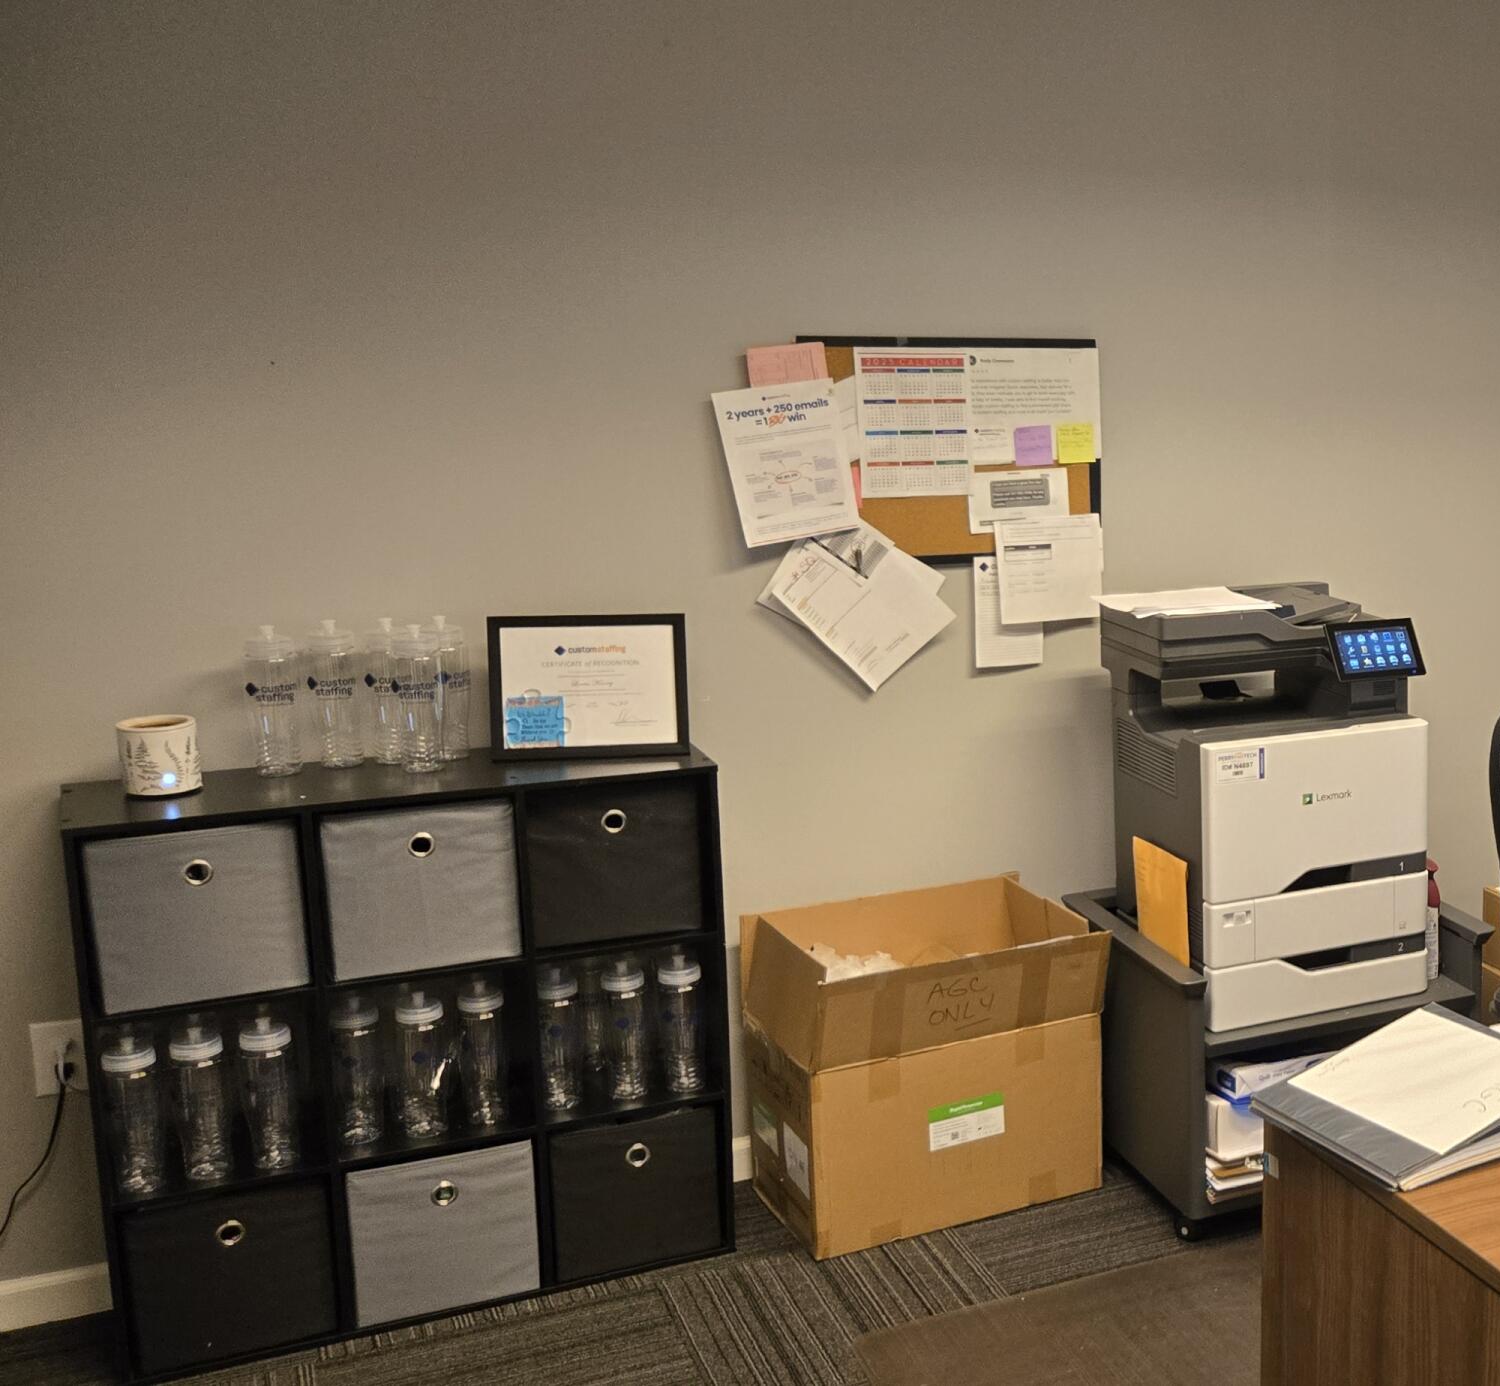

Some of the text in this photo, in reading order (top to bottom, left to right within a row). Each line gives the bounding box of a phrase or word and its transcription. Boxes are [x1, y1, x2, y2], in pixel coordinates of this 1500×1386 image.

[899, 358, 960, 366] CALENDAR
[725, 410, 734, 421] 2
[734, 407, 765, 422] years
[773, 402, 793, 414] 250
[794, 397, 829, 411] emails
[787, 411, 807, 423] win
[593, 659, 640, 667] RECOGNITION
[260, 683, 298, 694] custom
[319, 677, 356, 688] custom
[256, 691, 295, 703] staffing
[315, 686, 353, 698] staffing
[399, 690, 435, 702] staffing
[1316, 789, 1352, 802] Lexmark
[1399, 861, 1405, 872] 1
[1398, 942, 1404, 952] 2
[926, 976, 989, 1005] AGC
[928, 993, 995, 1026] ONLY
